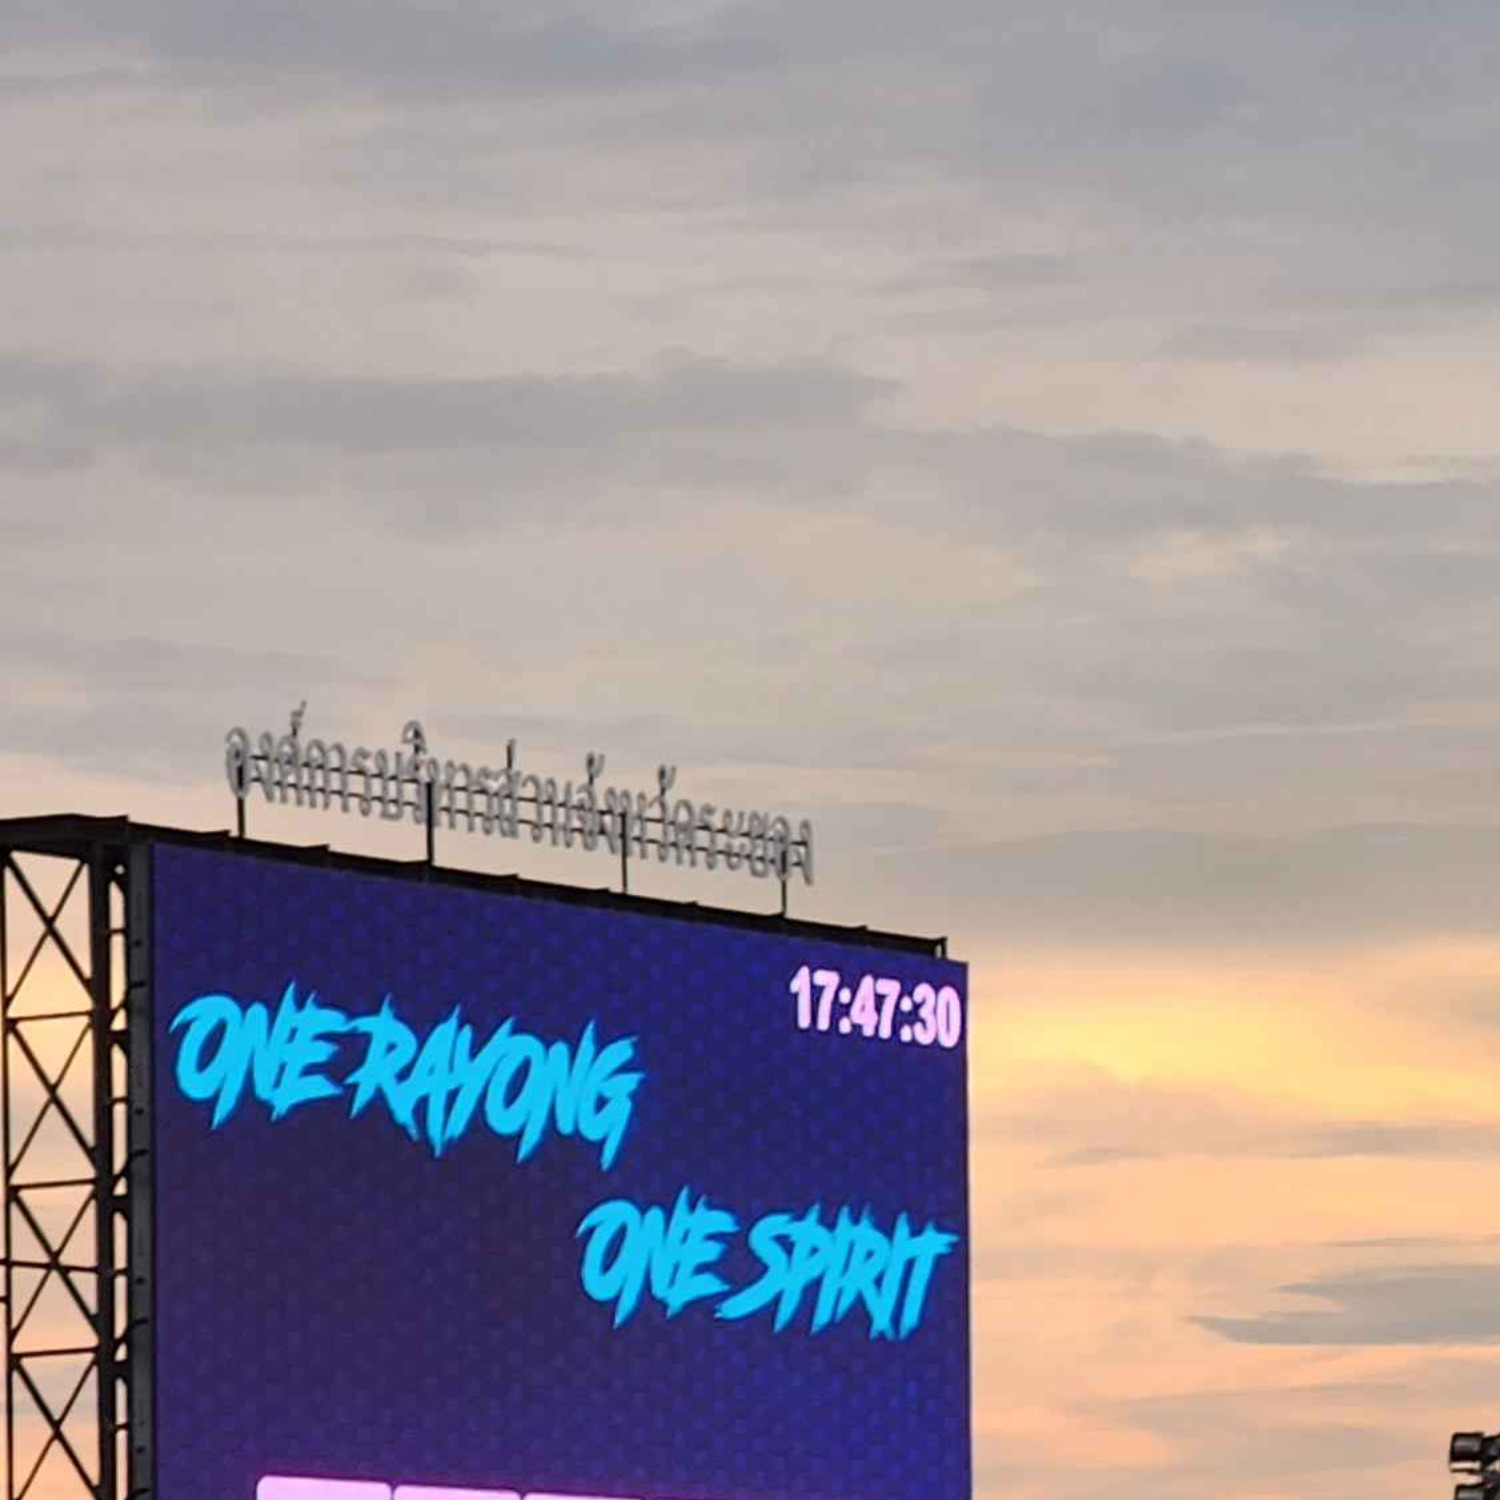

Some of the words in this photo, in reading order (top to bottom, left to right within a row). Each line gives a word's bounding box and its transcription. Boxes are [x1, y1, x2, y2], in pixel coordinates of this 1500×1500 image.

[169, 980, 347, 1130] ONE
[341, 993, 646, 1172] RAYONG
[789, 965, 962, 1049] 17:47:30
[575, 1186, 741, 1329] ONE
[714, 1203, 960, 1341] SPIRIT
